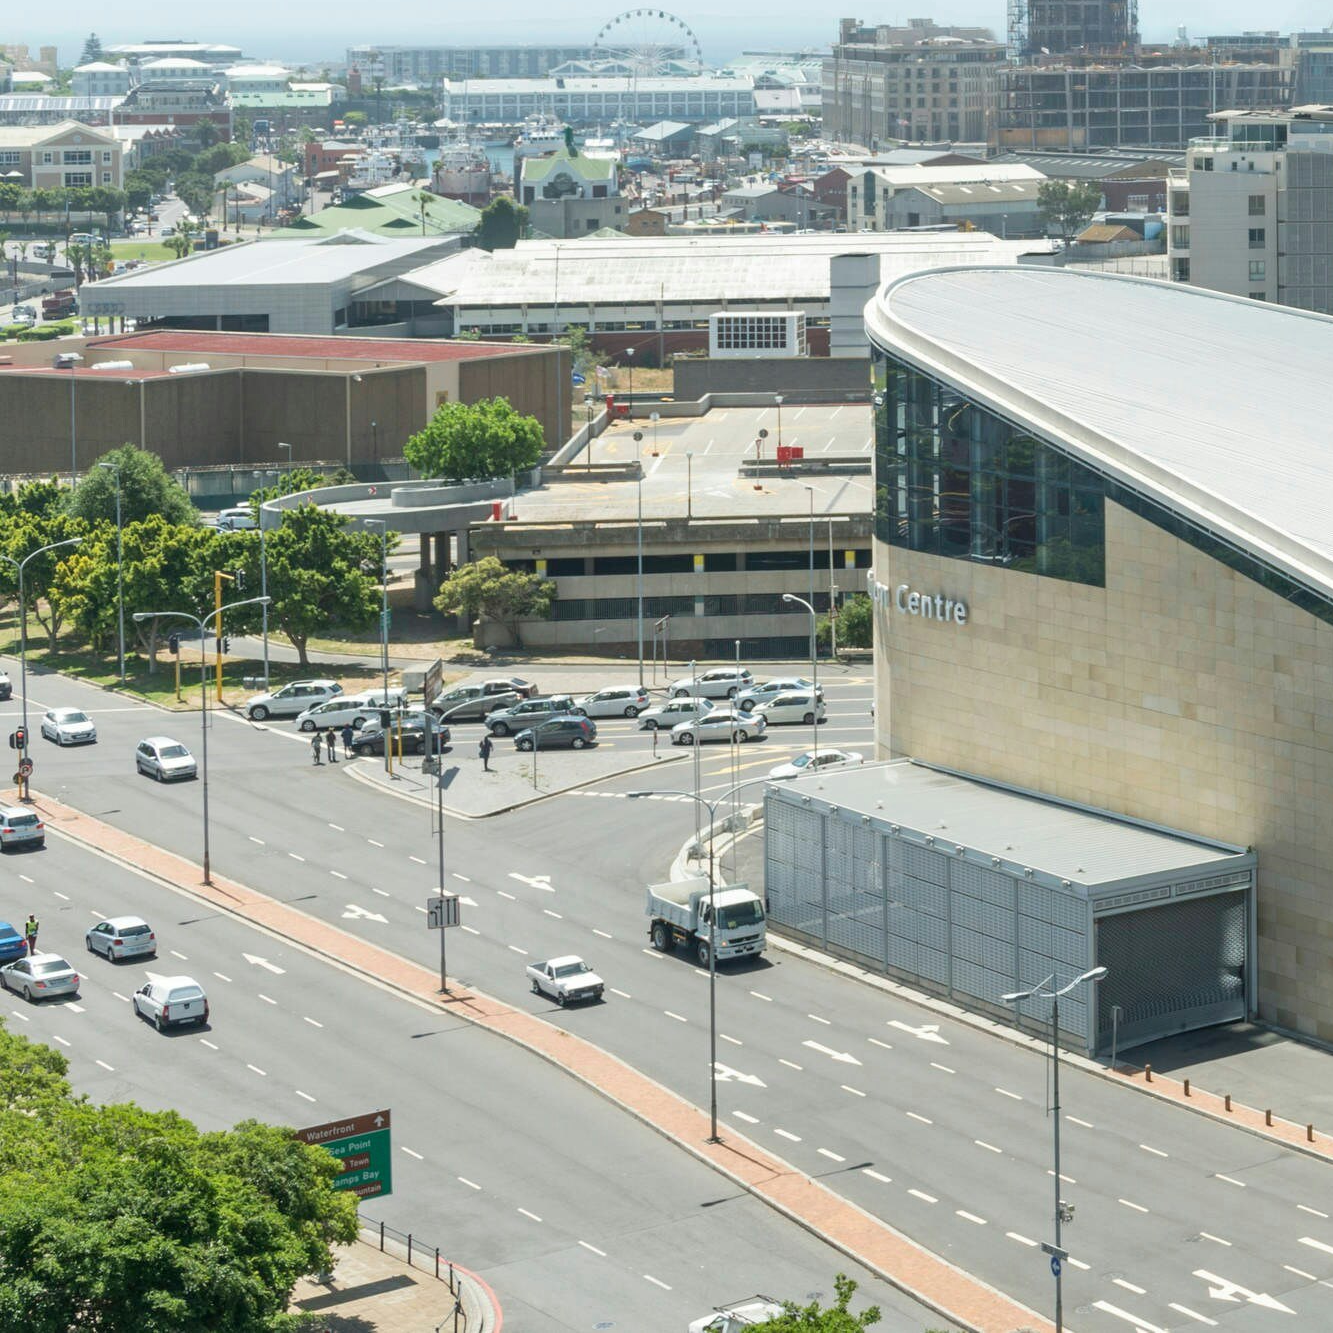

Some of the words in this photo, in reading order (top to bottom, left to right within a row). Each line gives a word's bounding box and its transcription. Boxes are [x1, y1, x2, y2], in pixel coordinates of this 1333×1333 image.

[896, 584, 967, 626] Centre
[306, 1123, 355, 1141] Waterfront
[348, 1139, 372, 1152] Point
[349, 1156, 370, 1168] Town
[362, 1170, 380, 1181] Bay
